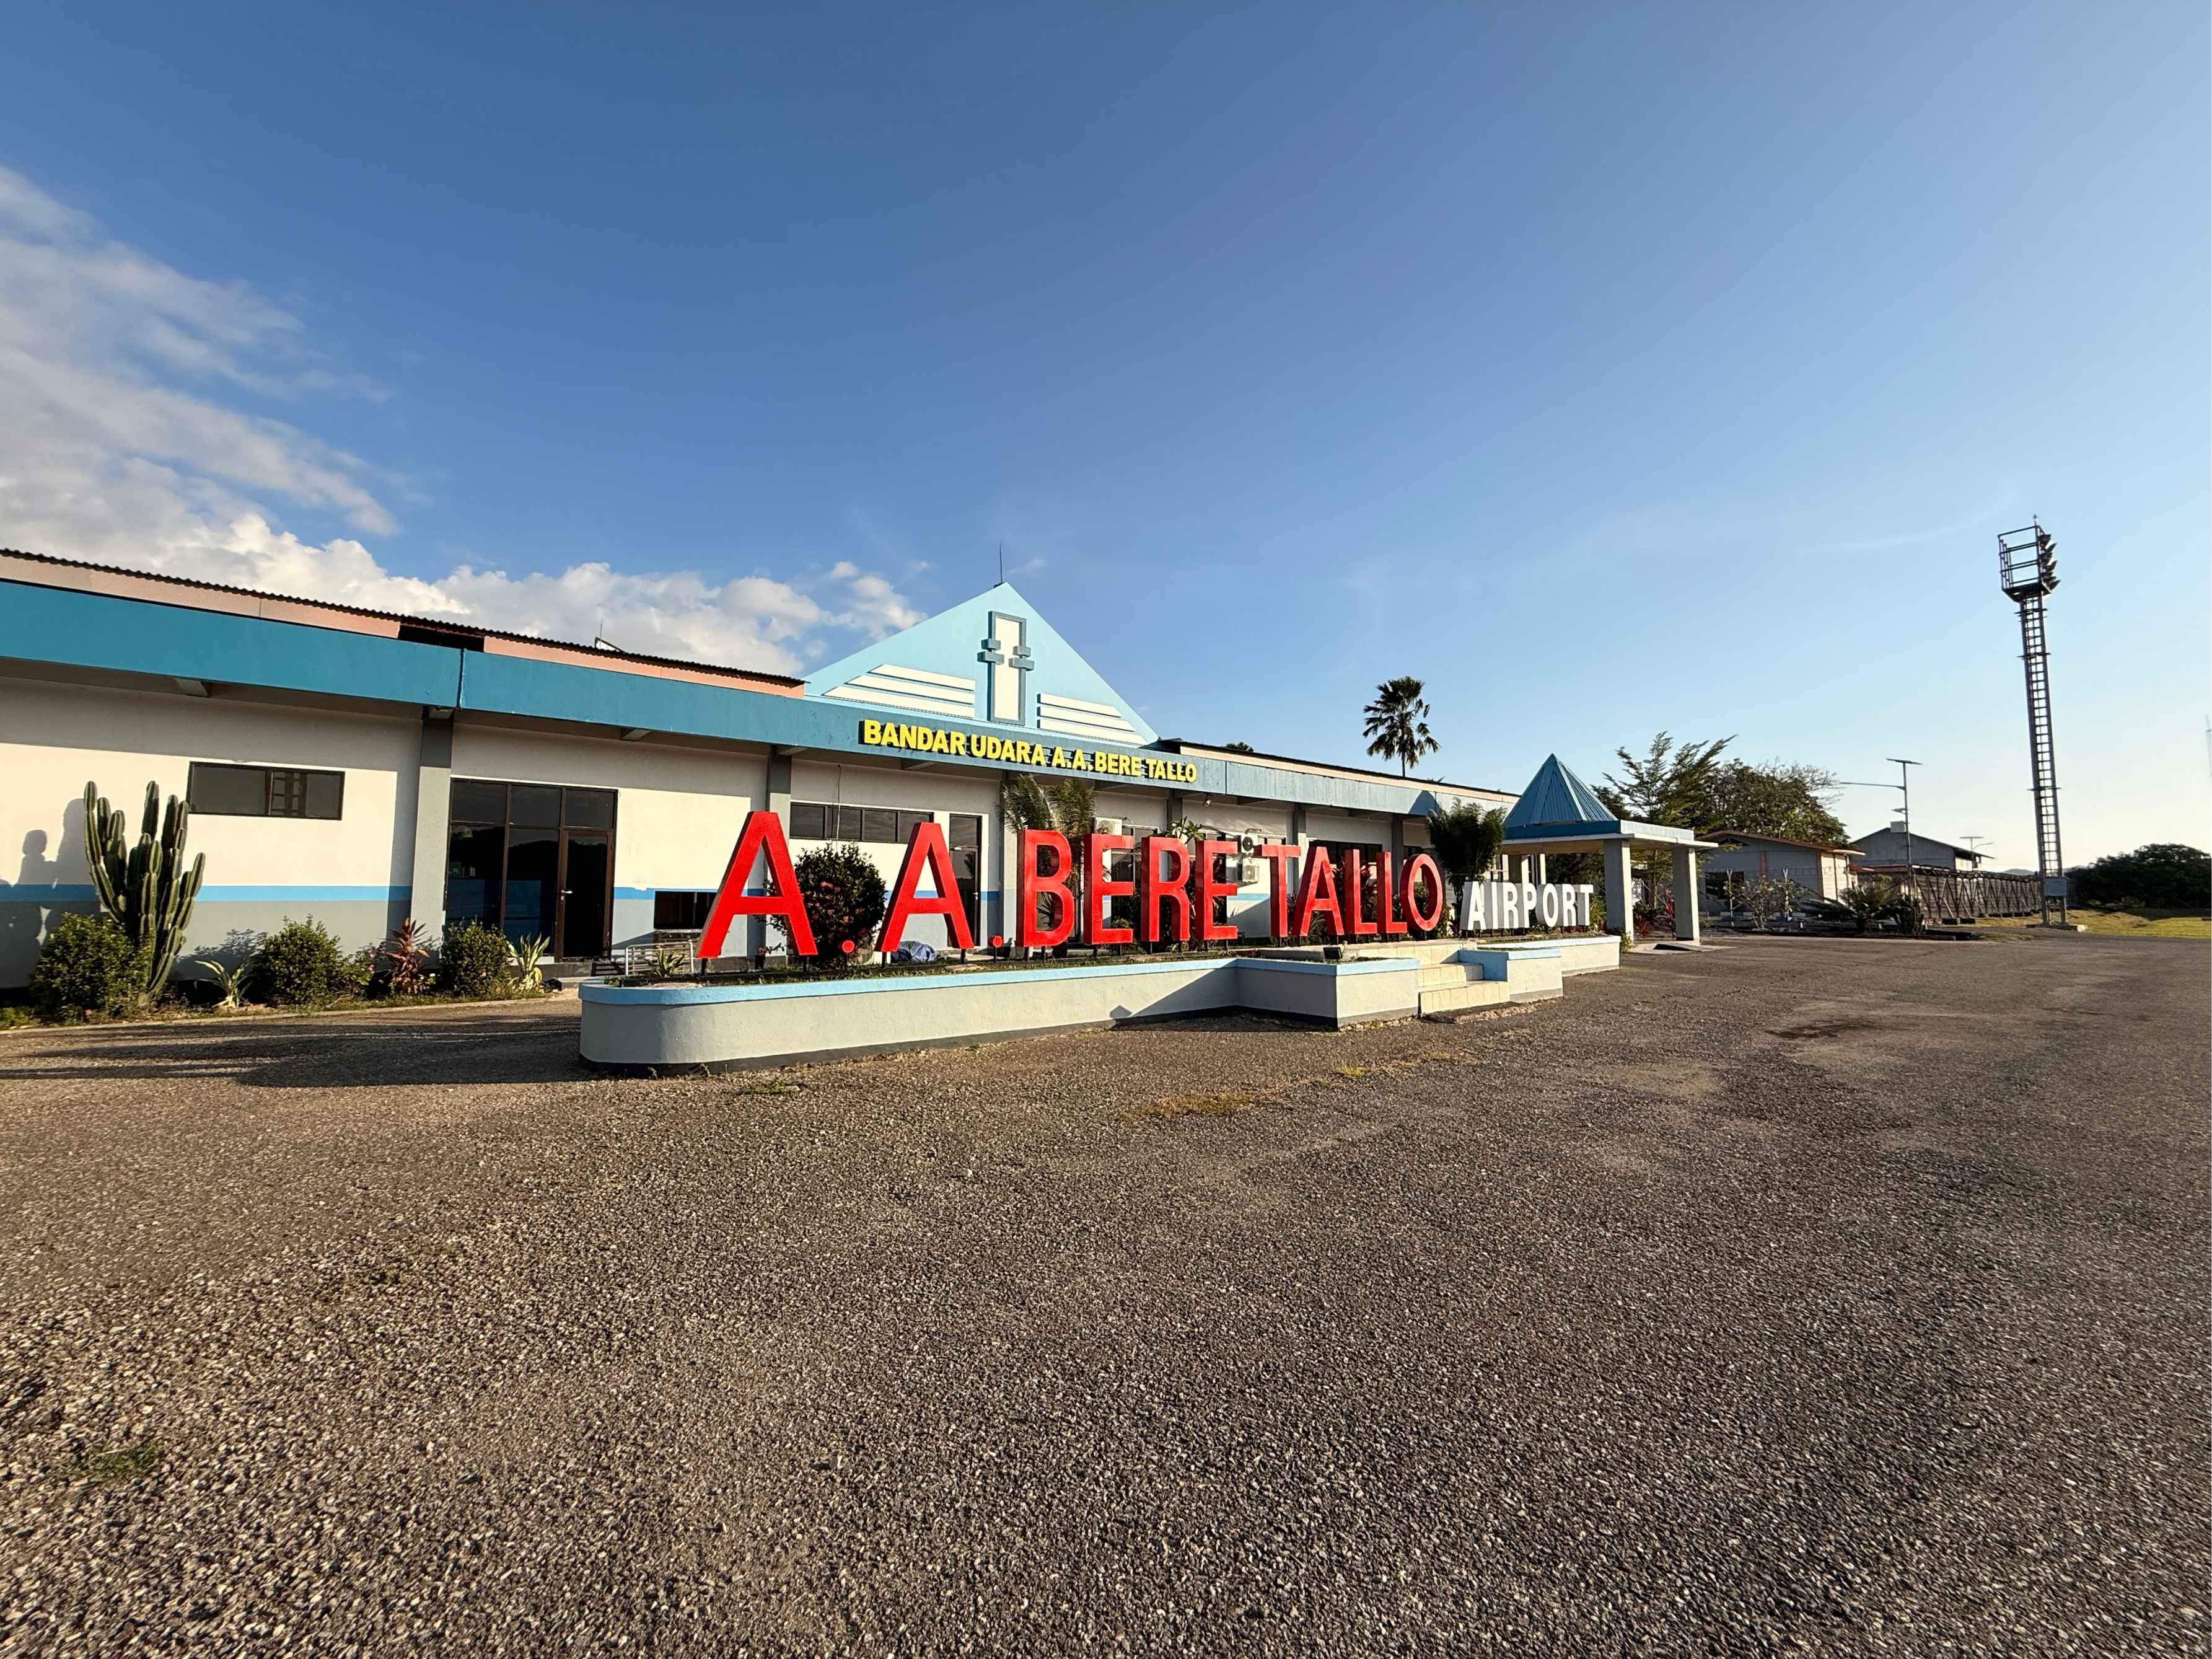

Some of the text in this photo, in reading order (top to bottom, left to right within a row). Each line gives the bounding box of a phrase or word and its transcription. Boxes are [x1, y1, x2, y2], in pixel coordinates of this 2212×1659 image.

[863, 719, 966, 755] BANDAR
[970, 734, 1045, 765] UDARA
[1095, 751, 1141, 777] BERE
[1146, 759, 1197, 783] TALLO
[1016, 829, 1238, 948] BERE
[1253, 844, 1444, 938] TALLO
[1460, 881, 1594, 930] AIRPORT
